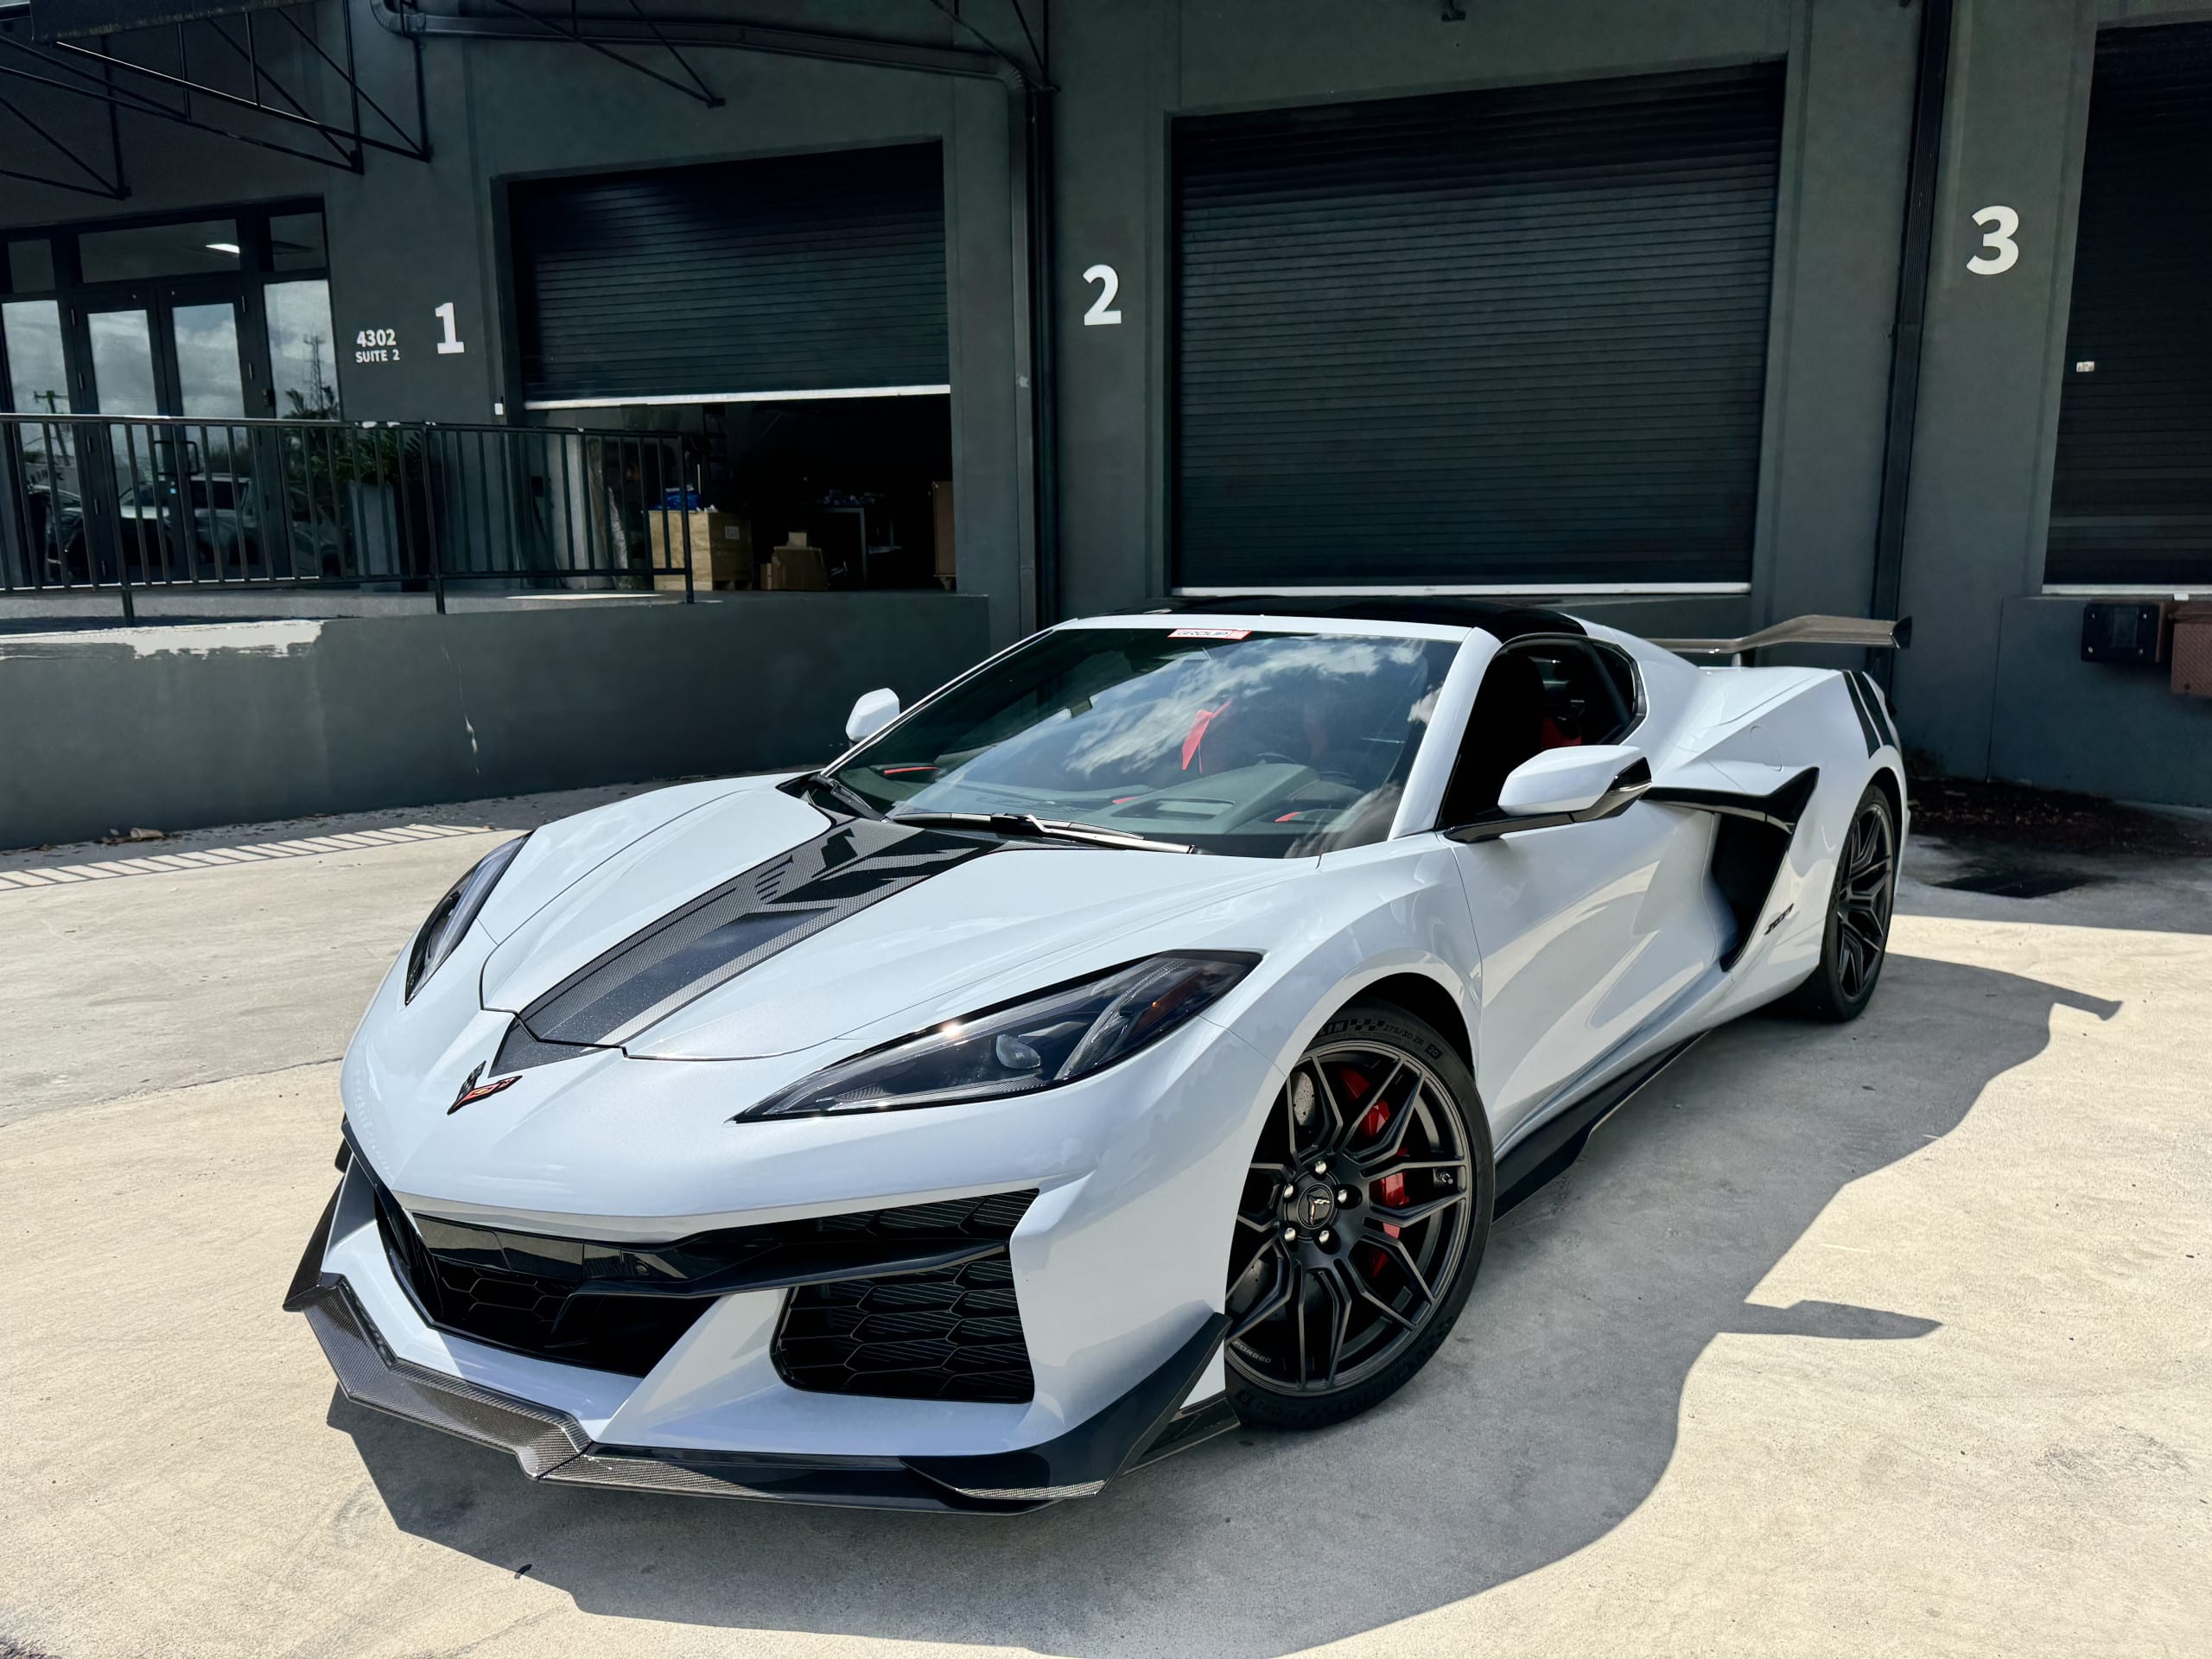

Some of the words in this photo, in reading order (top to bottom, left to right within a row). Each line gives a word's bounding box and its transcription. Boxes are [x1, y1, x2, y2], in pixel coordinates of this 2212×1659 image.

[1966, 205, 2019, 276] 3
[1083, 264, 1122, 326] 2
[356, 328, 397, 347] 4302
[435, 302, 465, 354] 1
[355, 350, 388, 363] SUITE
[392, 348, 400, 360] 2
